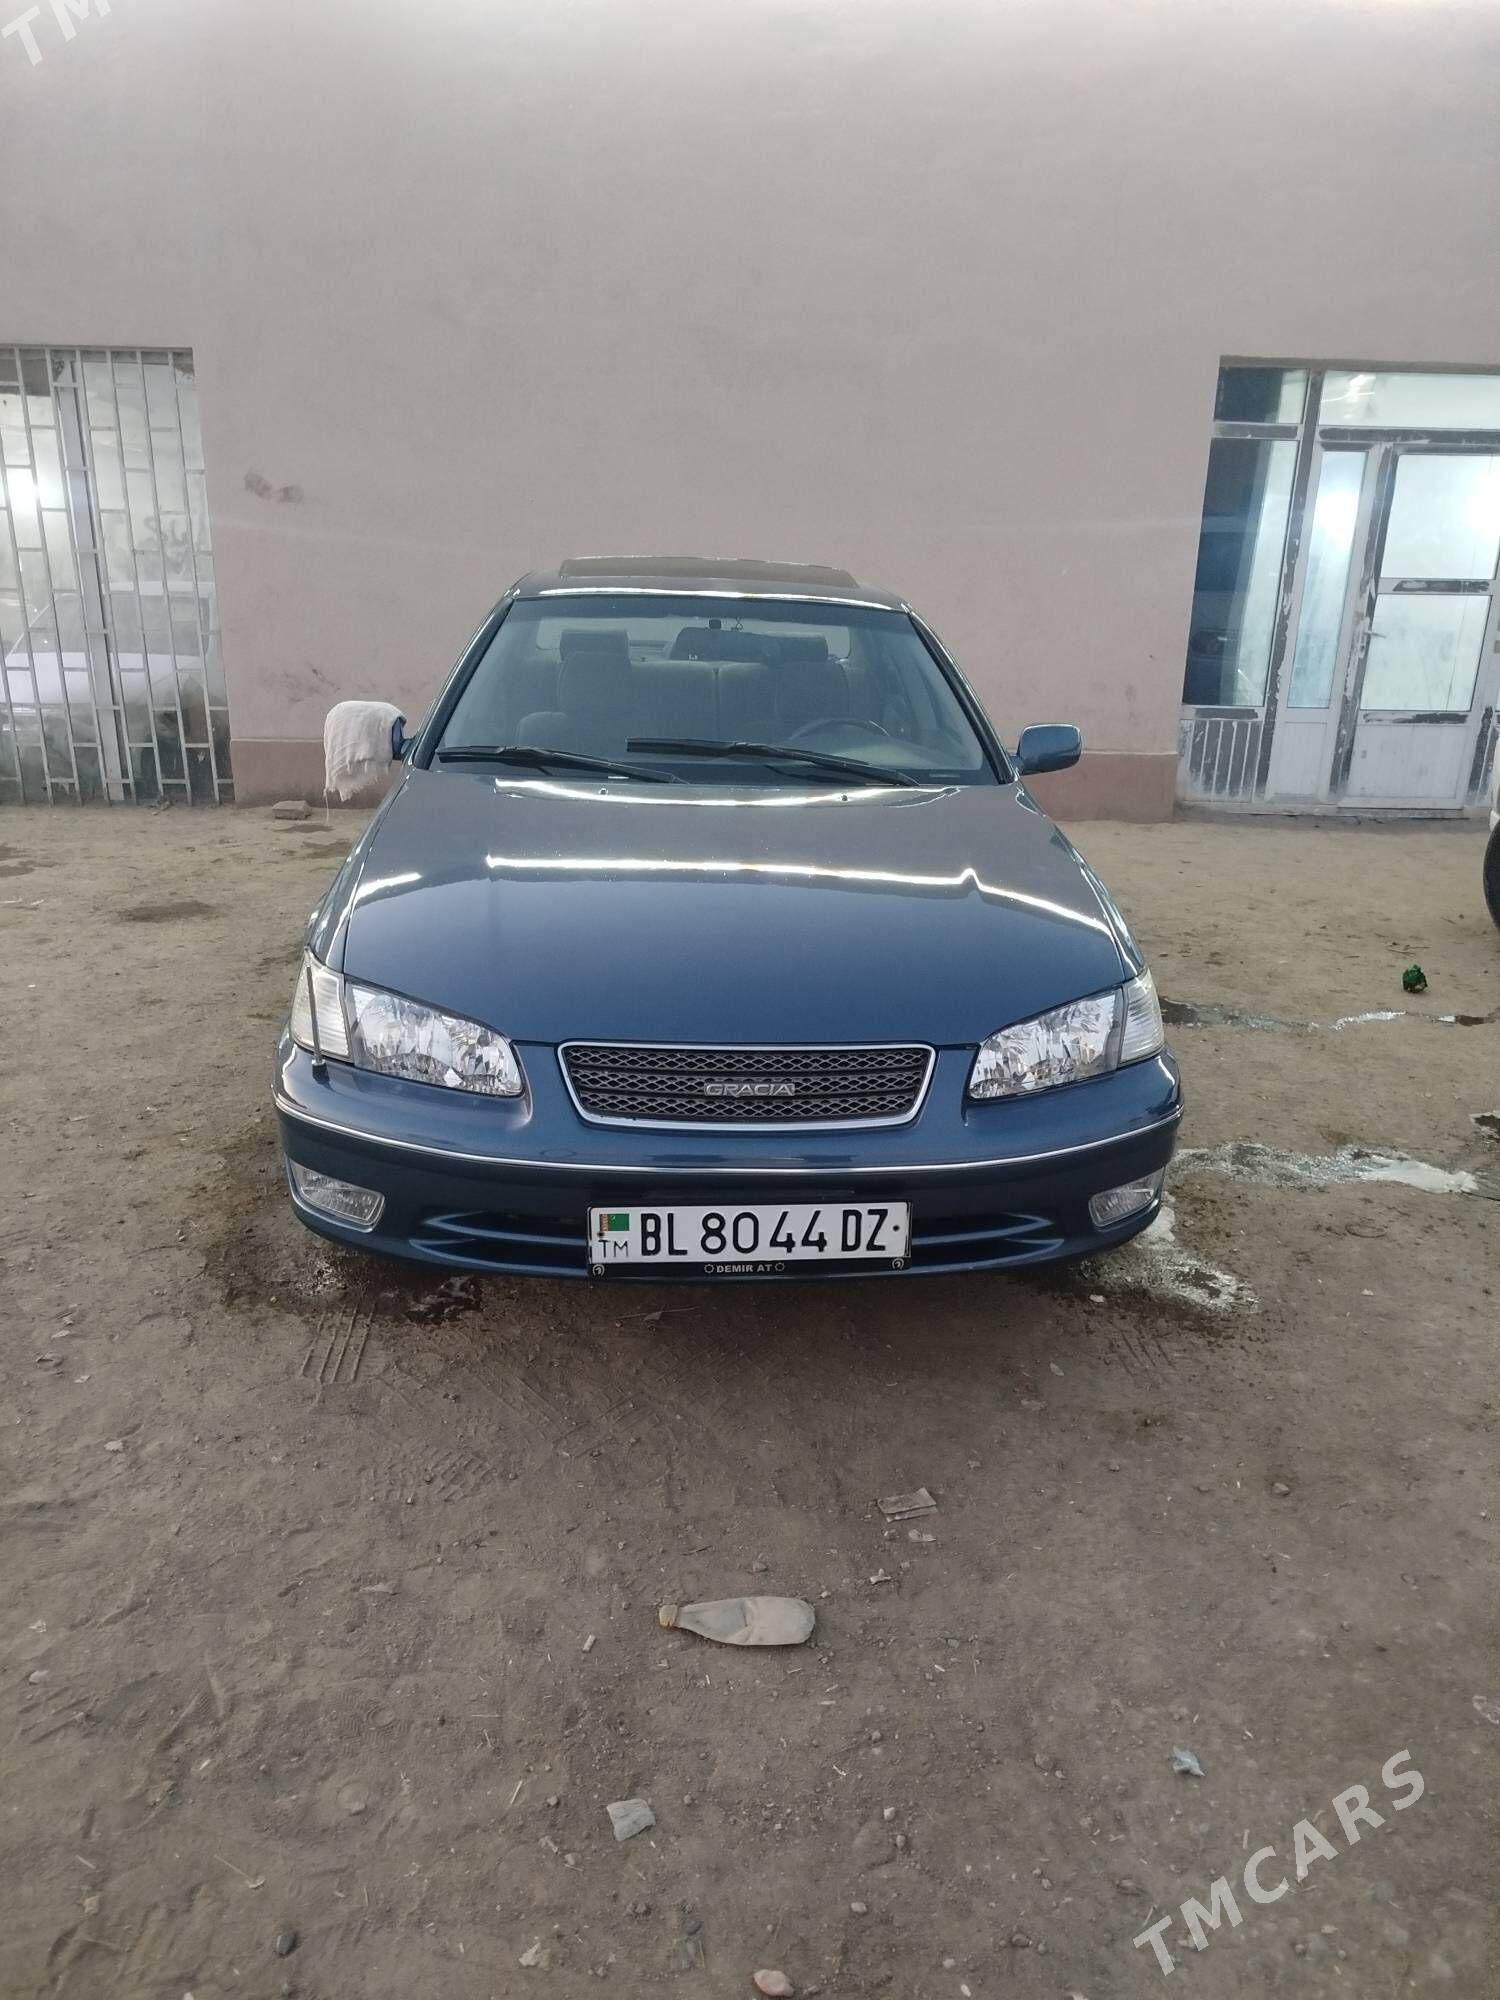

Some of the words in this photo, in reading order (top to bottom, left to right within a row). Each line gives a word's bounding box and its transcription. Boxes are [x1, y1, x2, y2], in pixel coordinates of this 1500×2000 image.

[705, 1083, 796, 1098] GRACIA
[640, 1212, 688, 1257] BL
[840, 1208, 889, 1252] DZ
[598, 1239, 629, 1258] TM
[716, 1264, 754, 1273] DEMIR
[756, 1263, 773, 1272] AT
